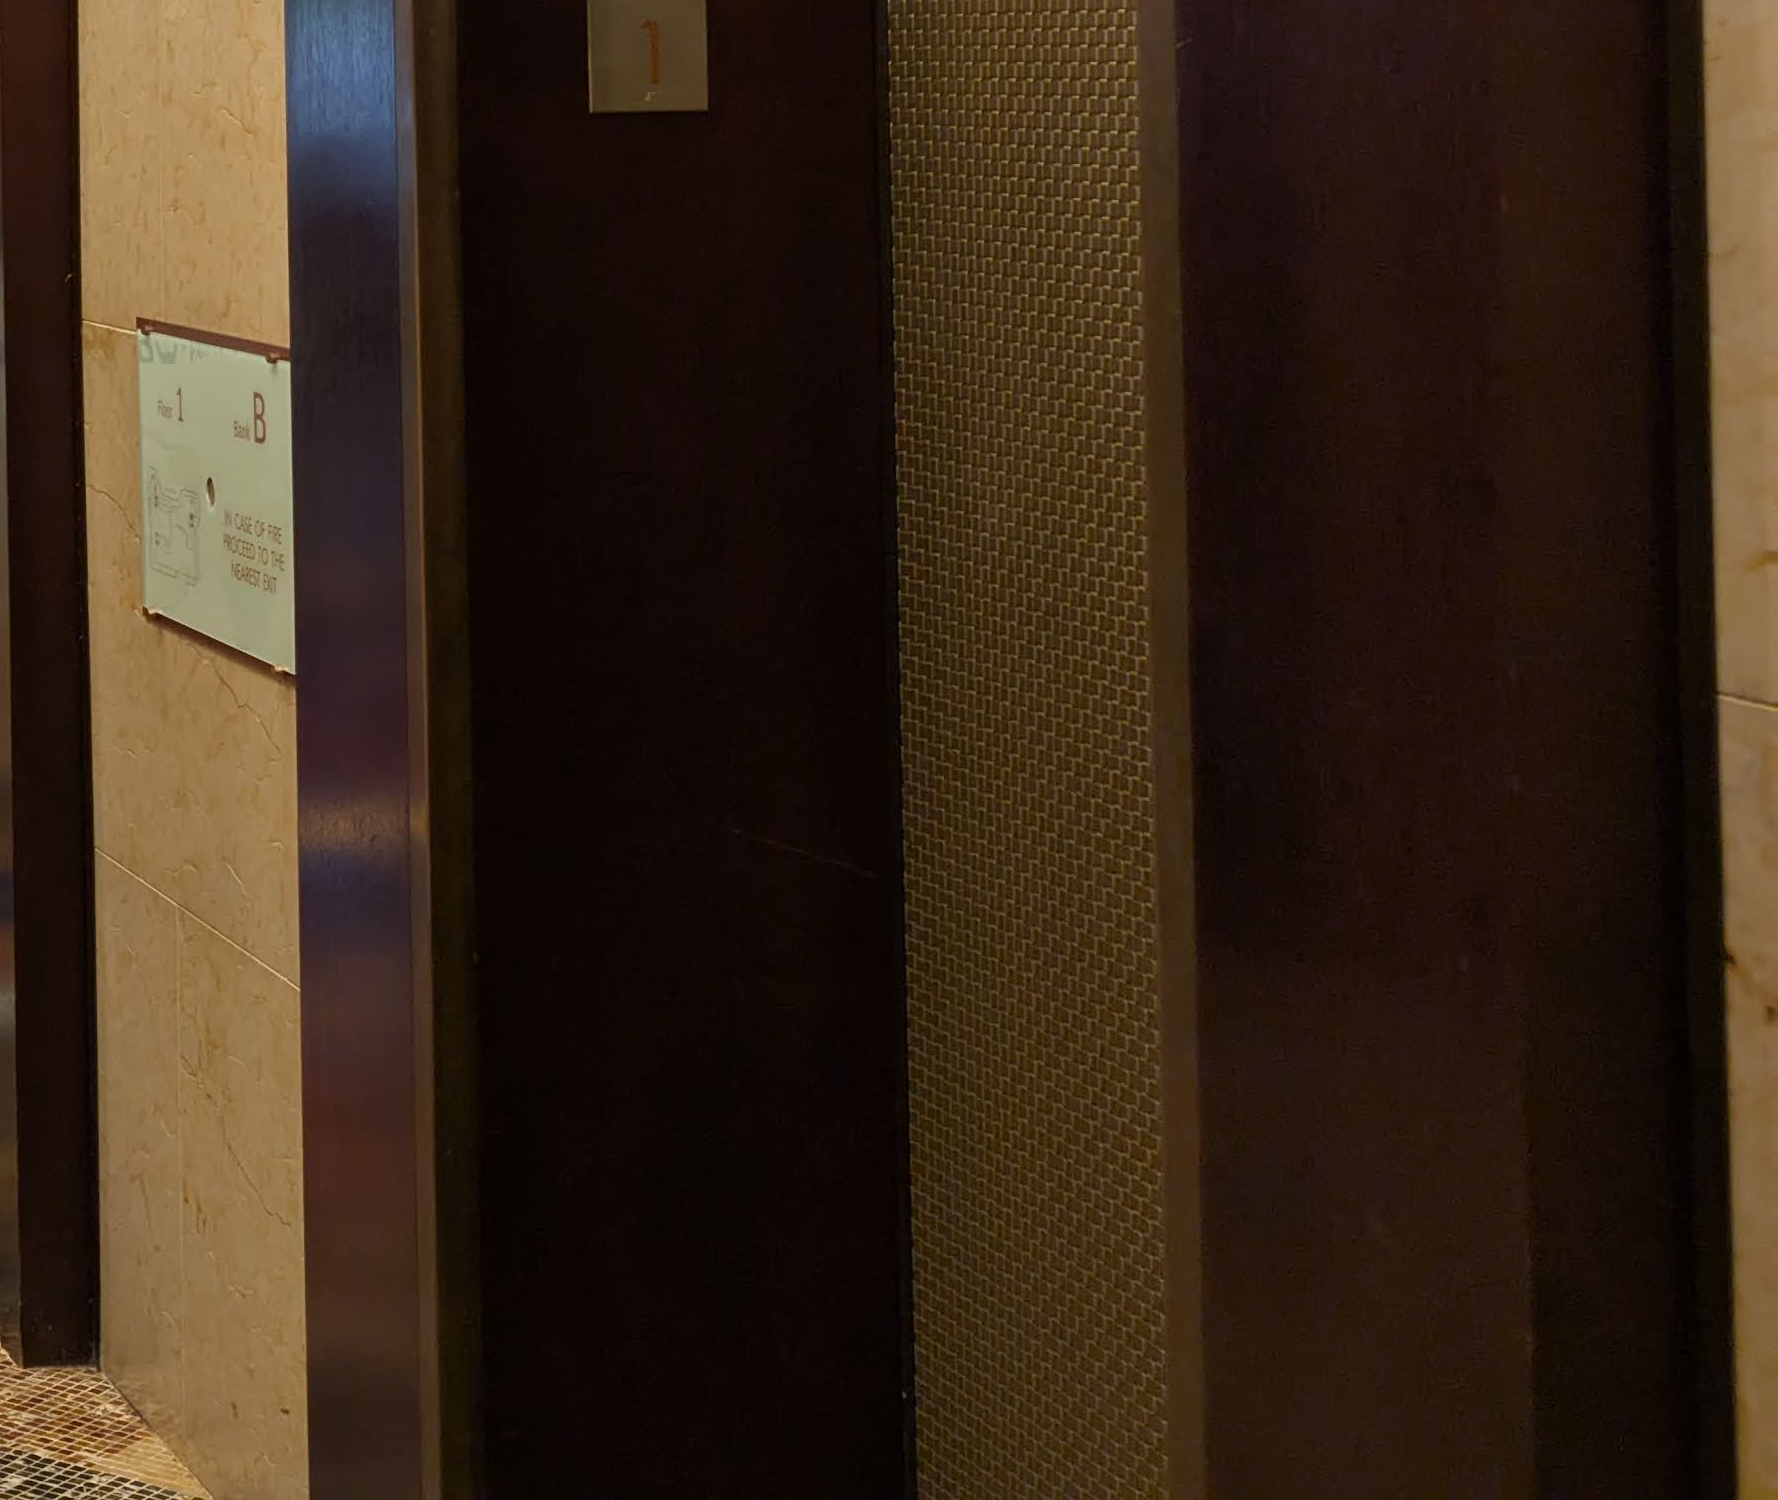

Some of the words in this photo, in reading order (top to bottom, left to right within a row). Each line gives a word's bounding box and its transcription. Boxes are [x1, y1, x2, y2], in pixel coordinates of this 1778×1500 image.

[640, 19, 659, 85] 1
[176, 387, 184, 422] 1
[253, 391, 266, 444] B
[255, 520, 265, 540] OF
[258, 545, 268, 565] TO
